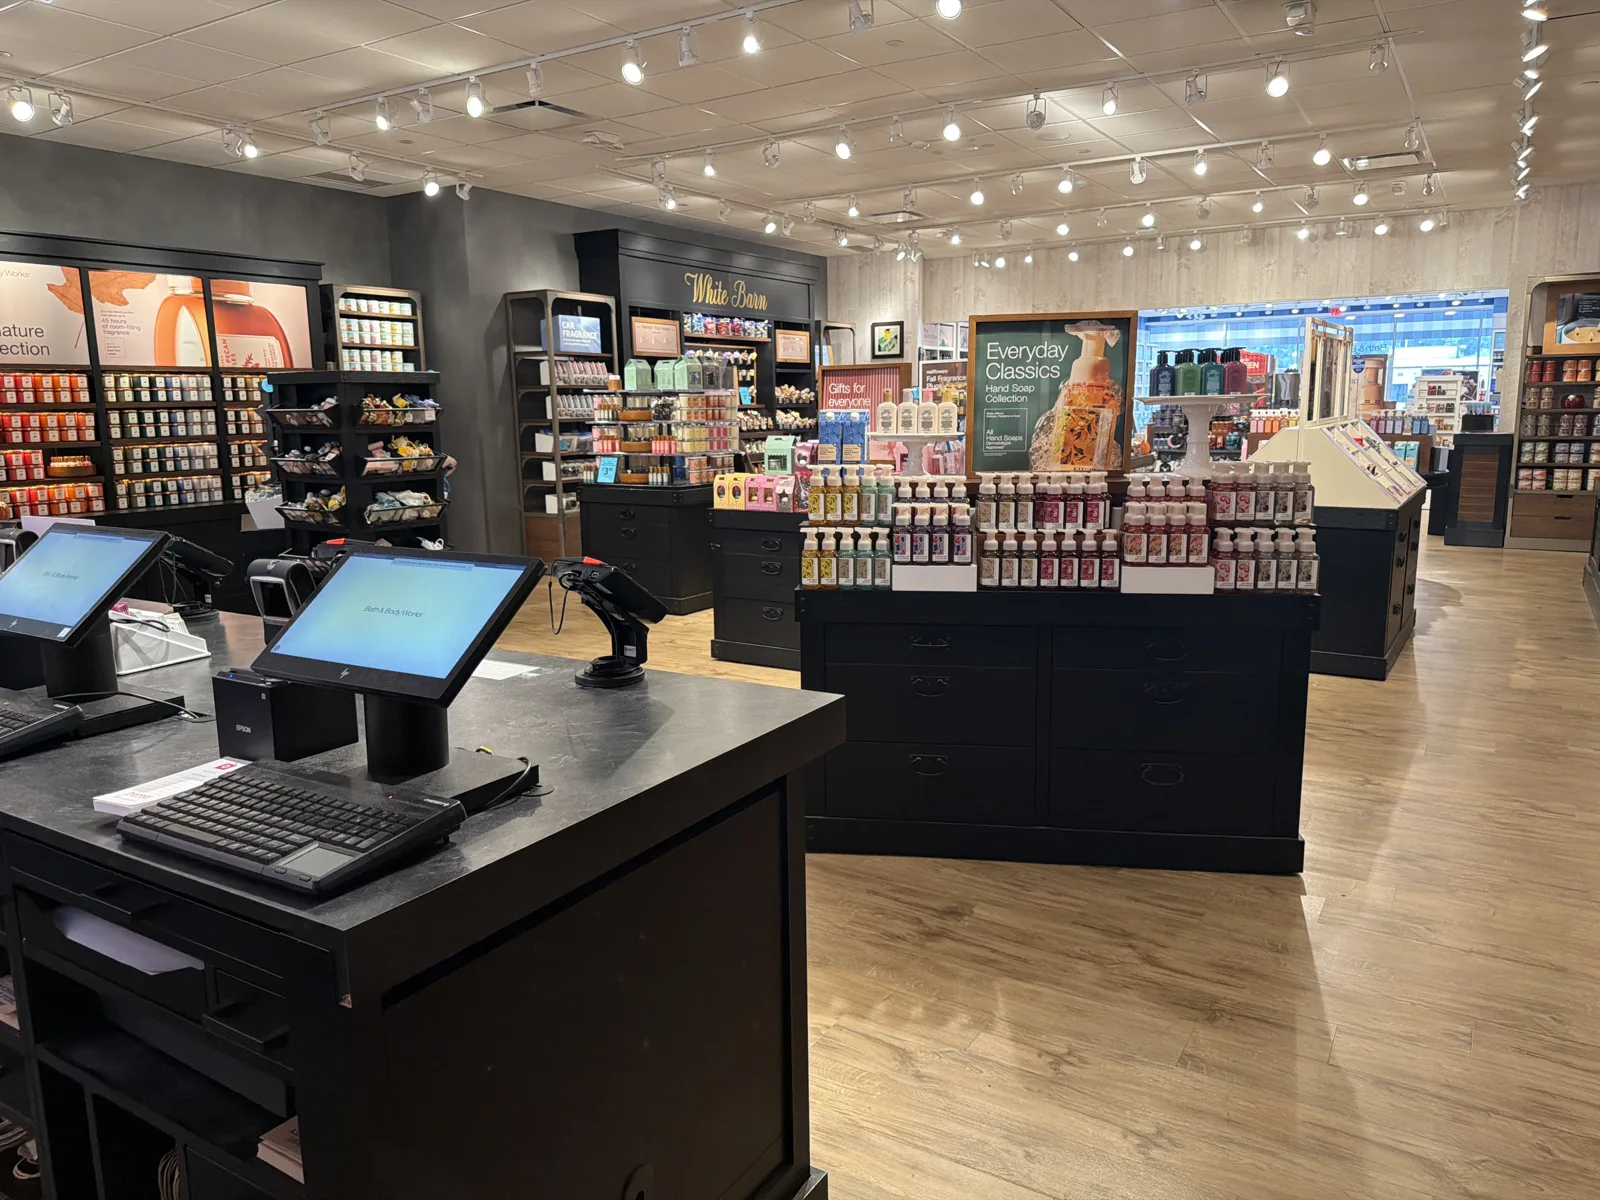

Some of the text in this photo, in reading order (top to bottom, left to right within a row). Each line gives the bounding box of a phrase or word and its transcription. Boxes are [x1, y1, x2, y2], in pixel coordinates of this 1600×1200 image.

[684, 272, 768, 310] White Barn
[562, 320, 574, 329] CAR
[562, 330, 598, 340] FRAGRANCE
[986, 341, 1068, 362] Everyday
[986, 362, 1060, 380] Classics
[938, 375, 966, 383] Fragrance
[828, 382, 866, 394] Gifts for
[986, 384, 1034, 394] Hand Soap
[828, 398, 871, 408] everyone
[985, 394, 1028, 402] Collection
[384, 608, 400, 616] Body
[401, 610, 422, 618] Works
[236, 724, 252, 734] EPSON
